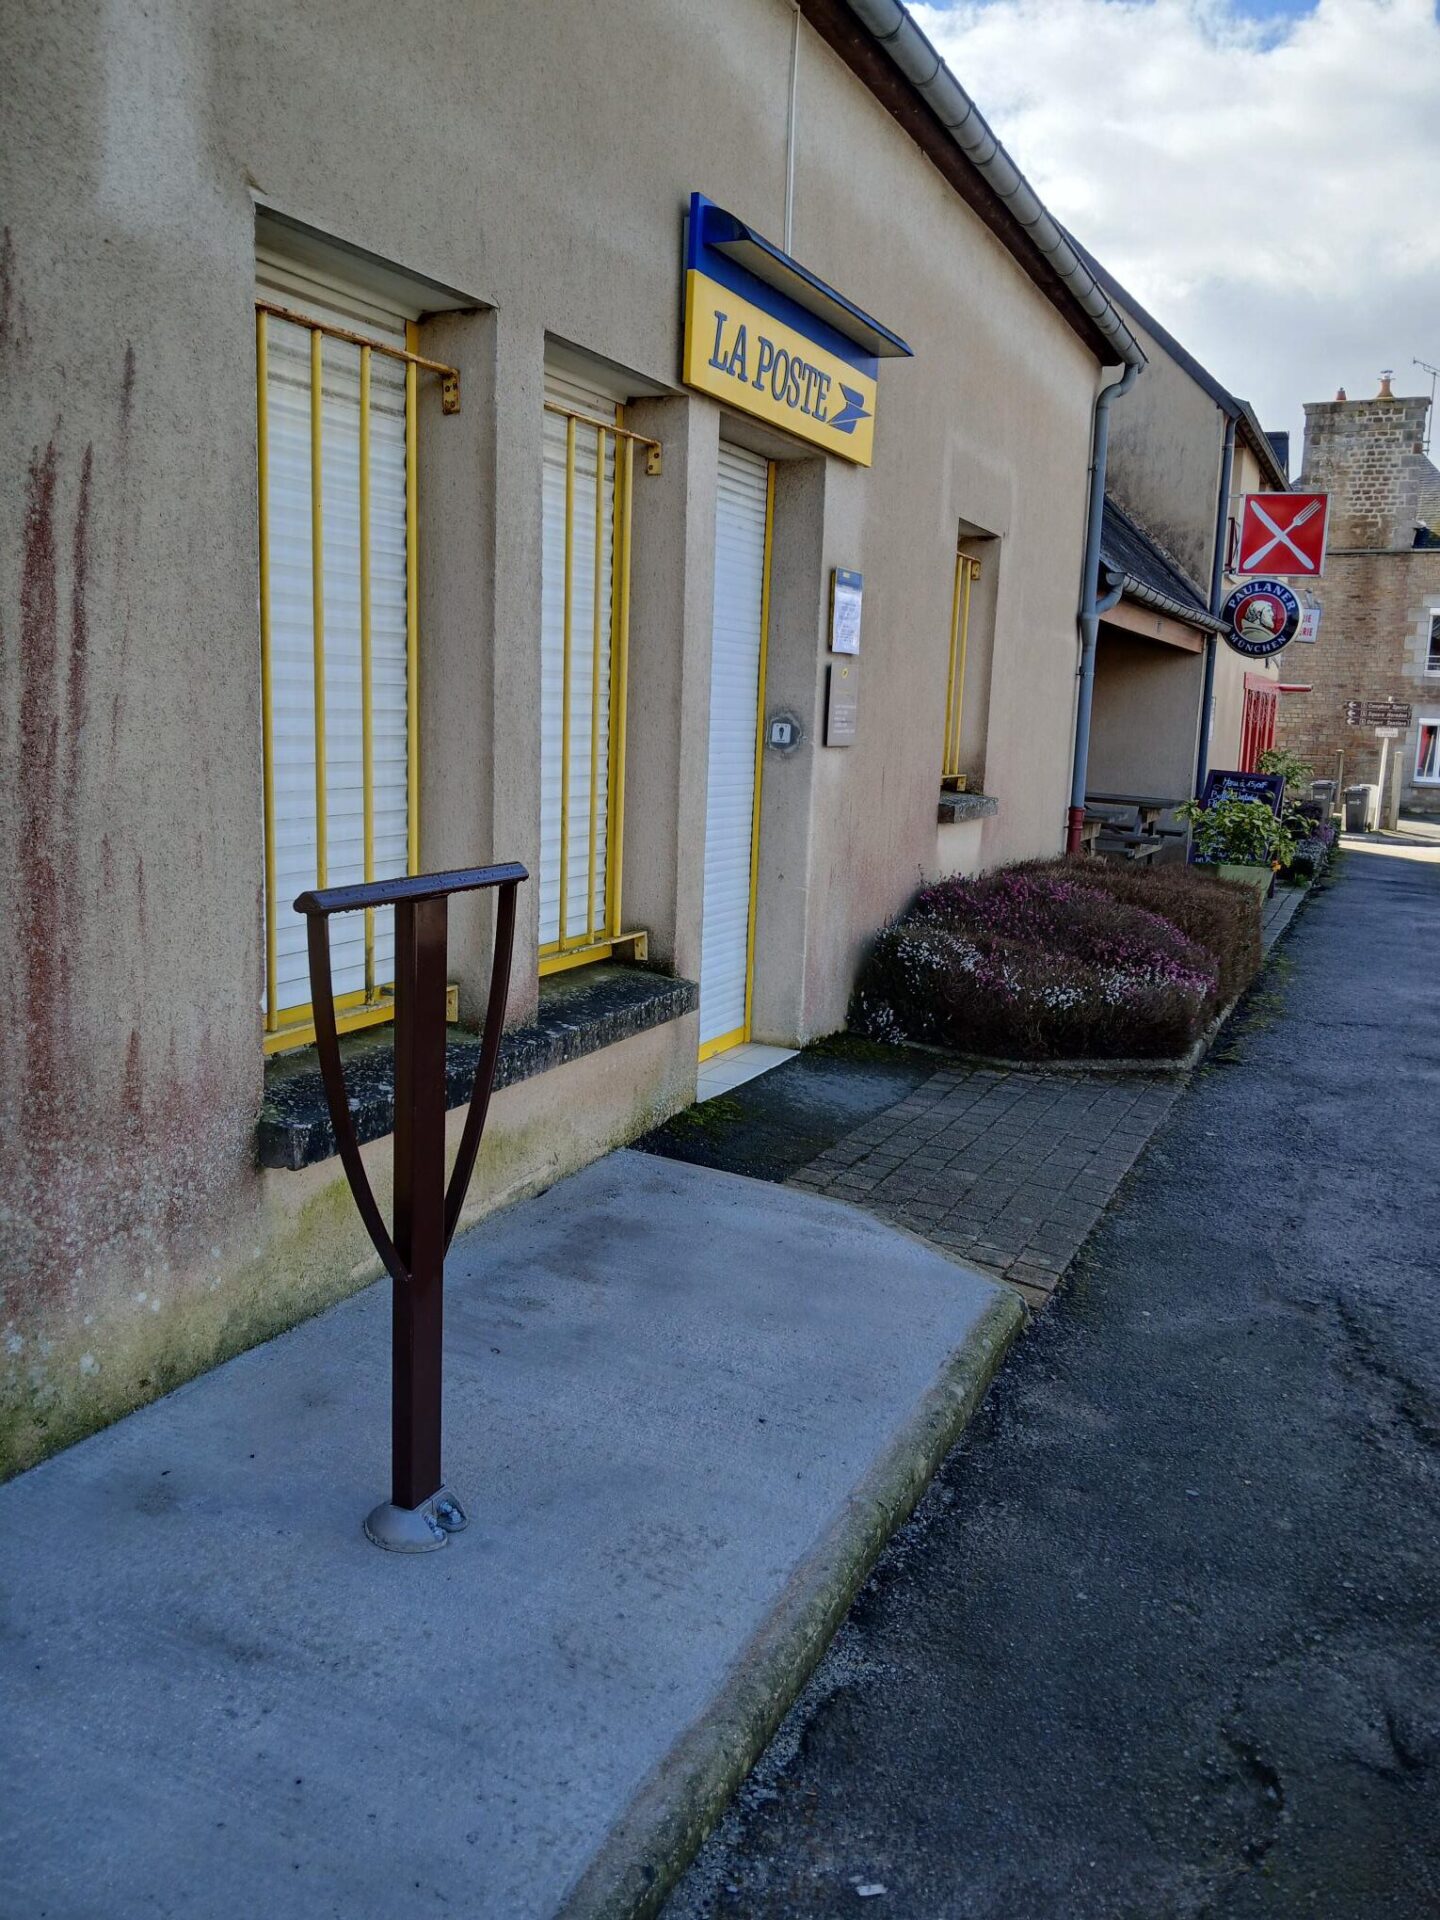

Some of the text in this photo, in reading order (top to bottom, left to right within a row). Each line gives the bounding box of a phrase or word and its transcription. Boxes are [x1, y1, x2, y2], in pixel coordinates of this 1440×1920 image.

[708, 310, 832, 423] LA POSTE
[1228, 583, 1296, 610] PAULANER
